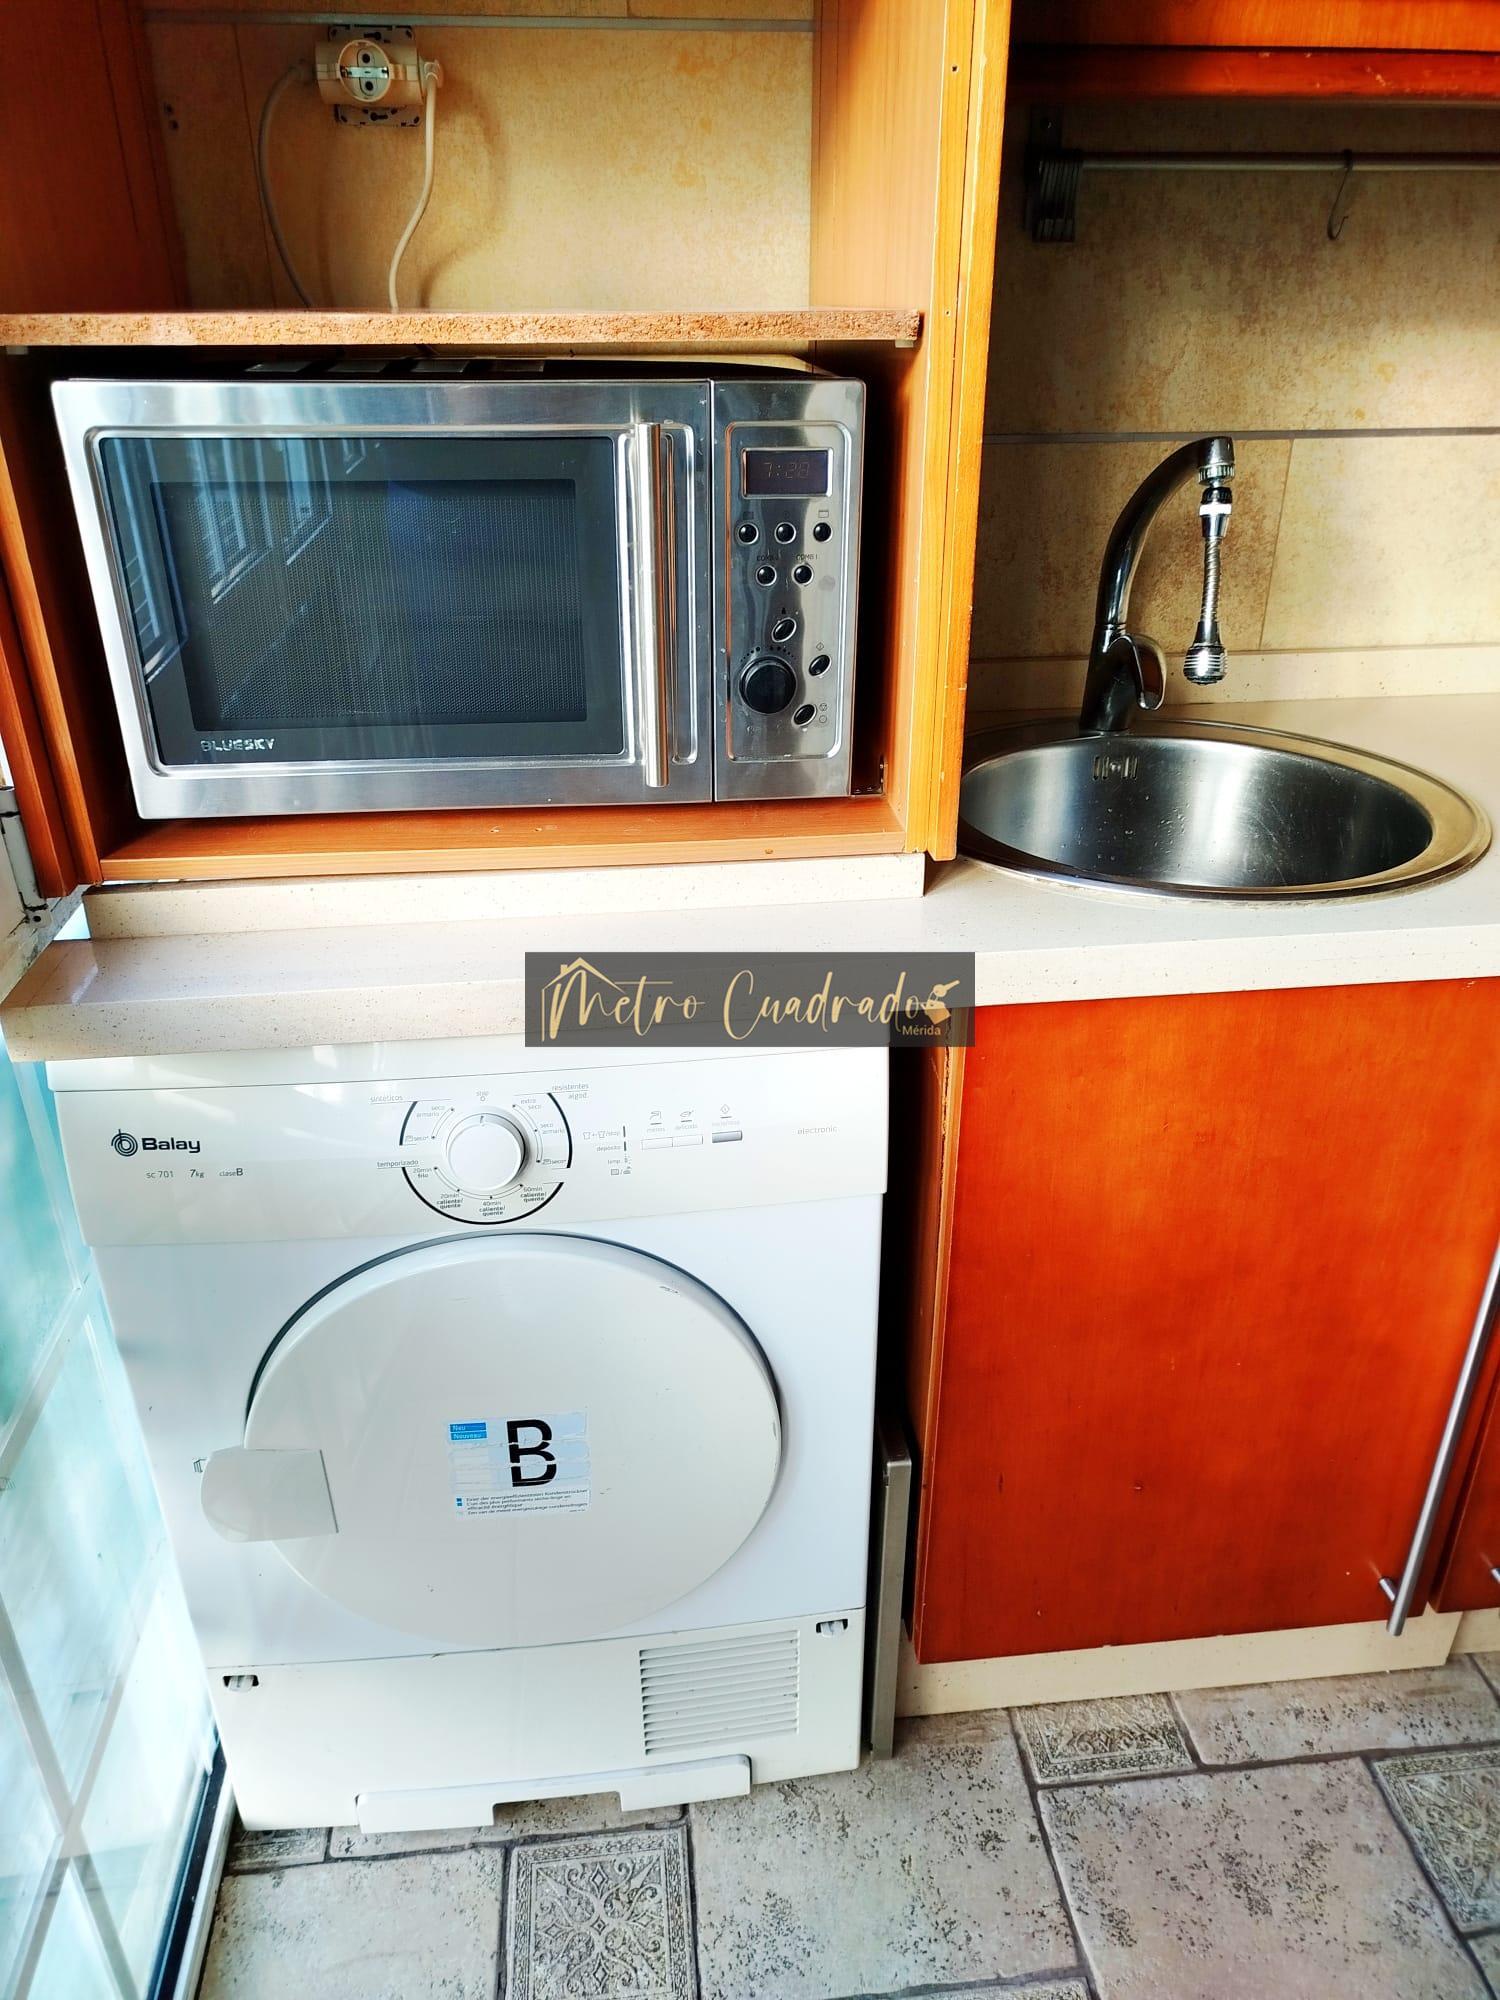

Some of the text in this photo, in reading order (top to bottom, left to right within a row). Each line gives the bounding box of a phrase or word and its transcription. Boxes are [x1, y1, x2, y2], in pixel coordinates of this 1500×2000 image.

[200, 738, 275, 752] BLUESKY
[797, 1125, 838, 1136] electronic
[141, 1137, 201, 1154] Balay
[377, 1159, 419, 1168] temporizado
[145, 1171, 156, 1179] sc
[158, 1170, 174, 1179] 701
[507, 1419, 557, 1488] B
